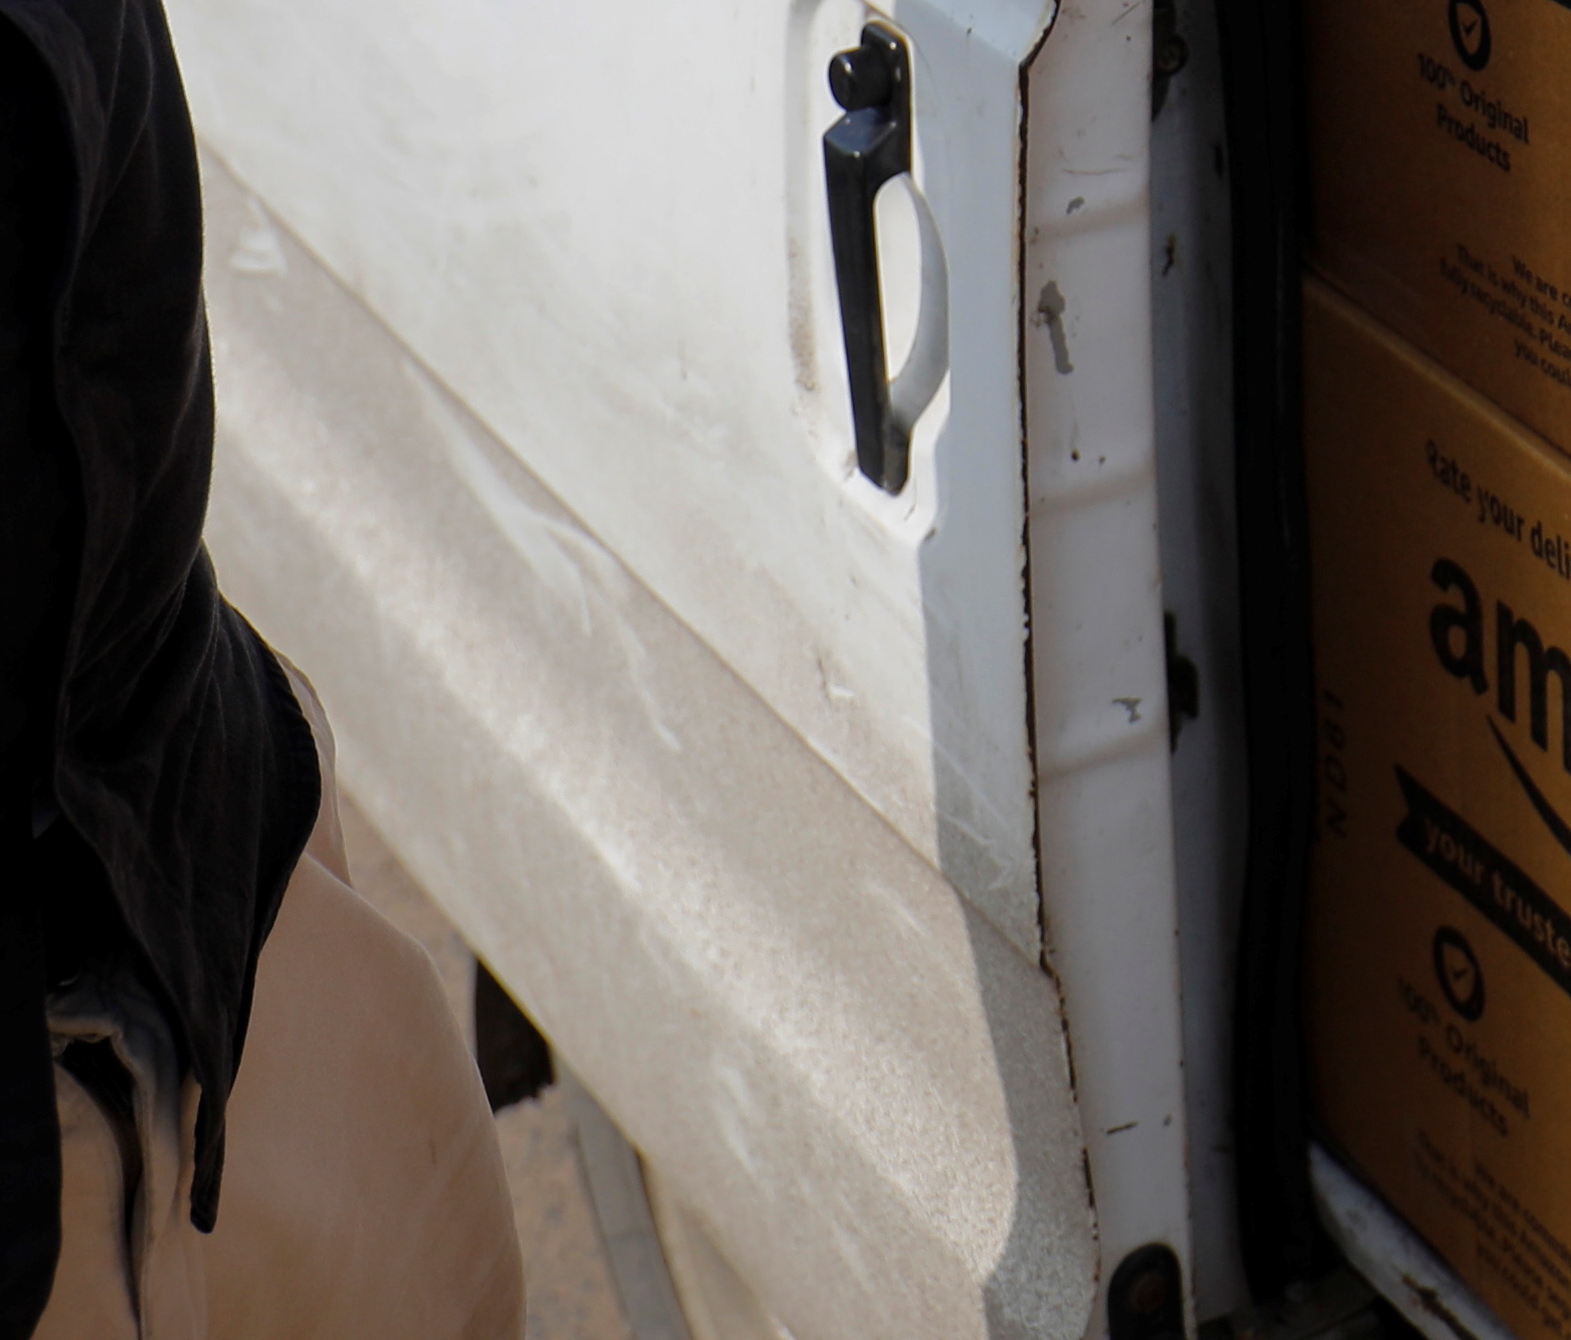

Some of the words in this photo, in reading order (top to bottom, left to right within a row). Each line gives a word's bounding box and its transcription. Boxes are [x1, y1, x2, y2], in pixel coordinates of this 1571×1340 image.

[1437, 104, 1510, 171] Products
[1460, 80, 1529, 144] Original
[1426, 438, 1473, 506] Rate
[1476, 482, 1526, 545] your
[1428, 823, 1487, 891] your
